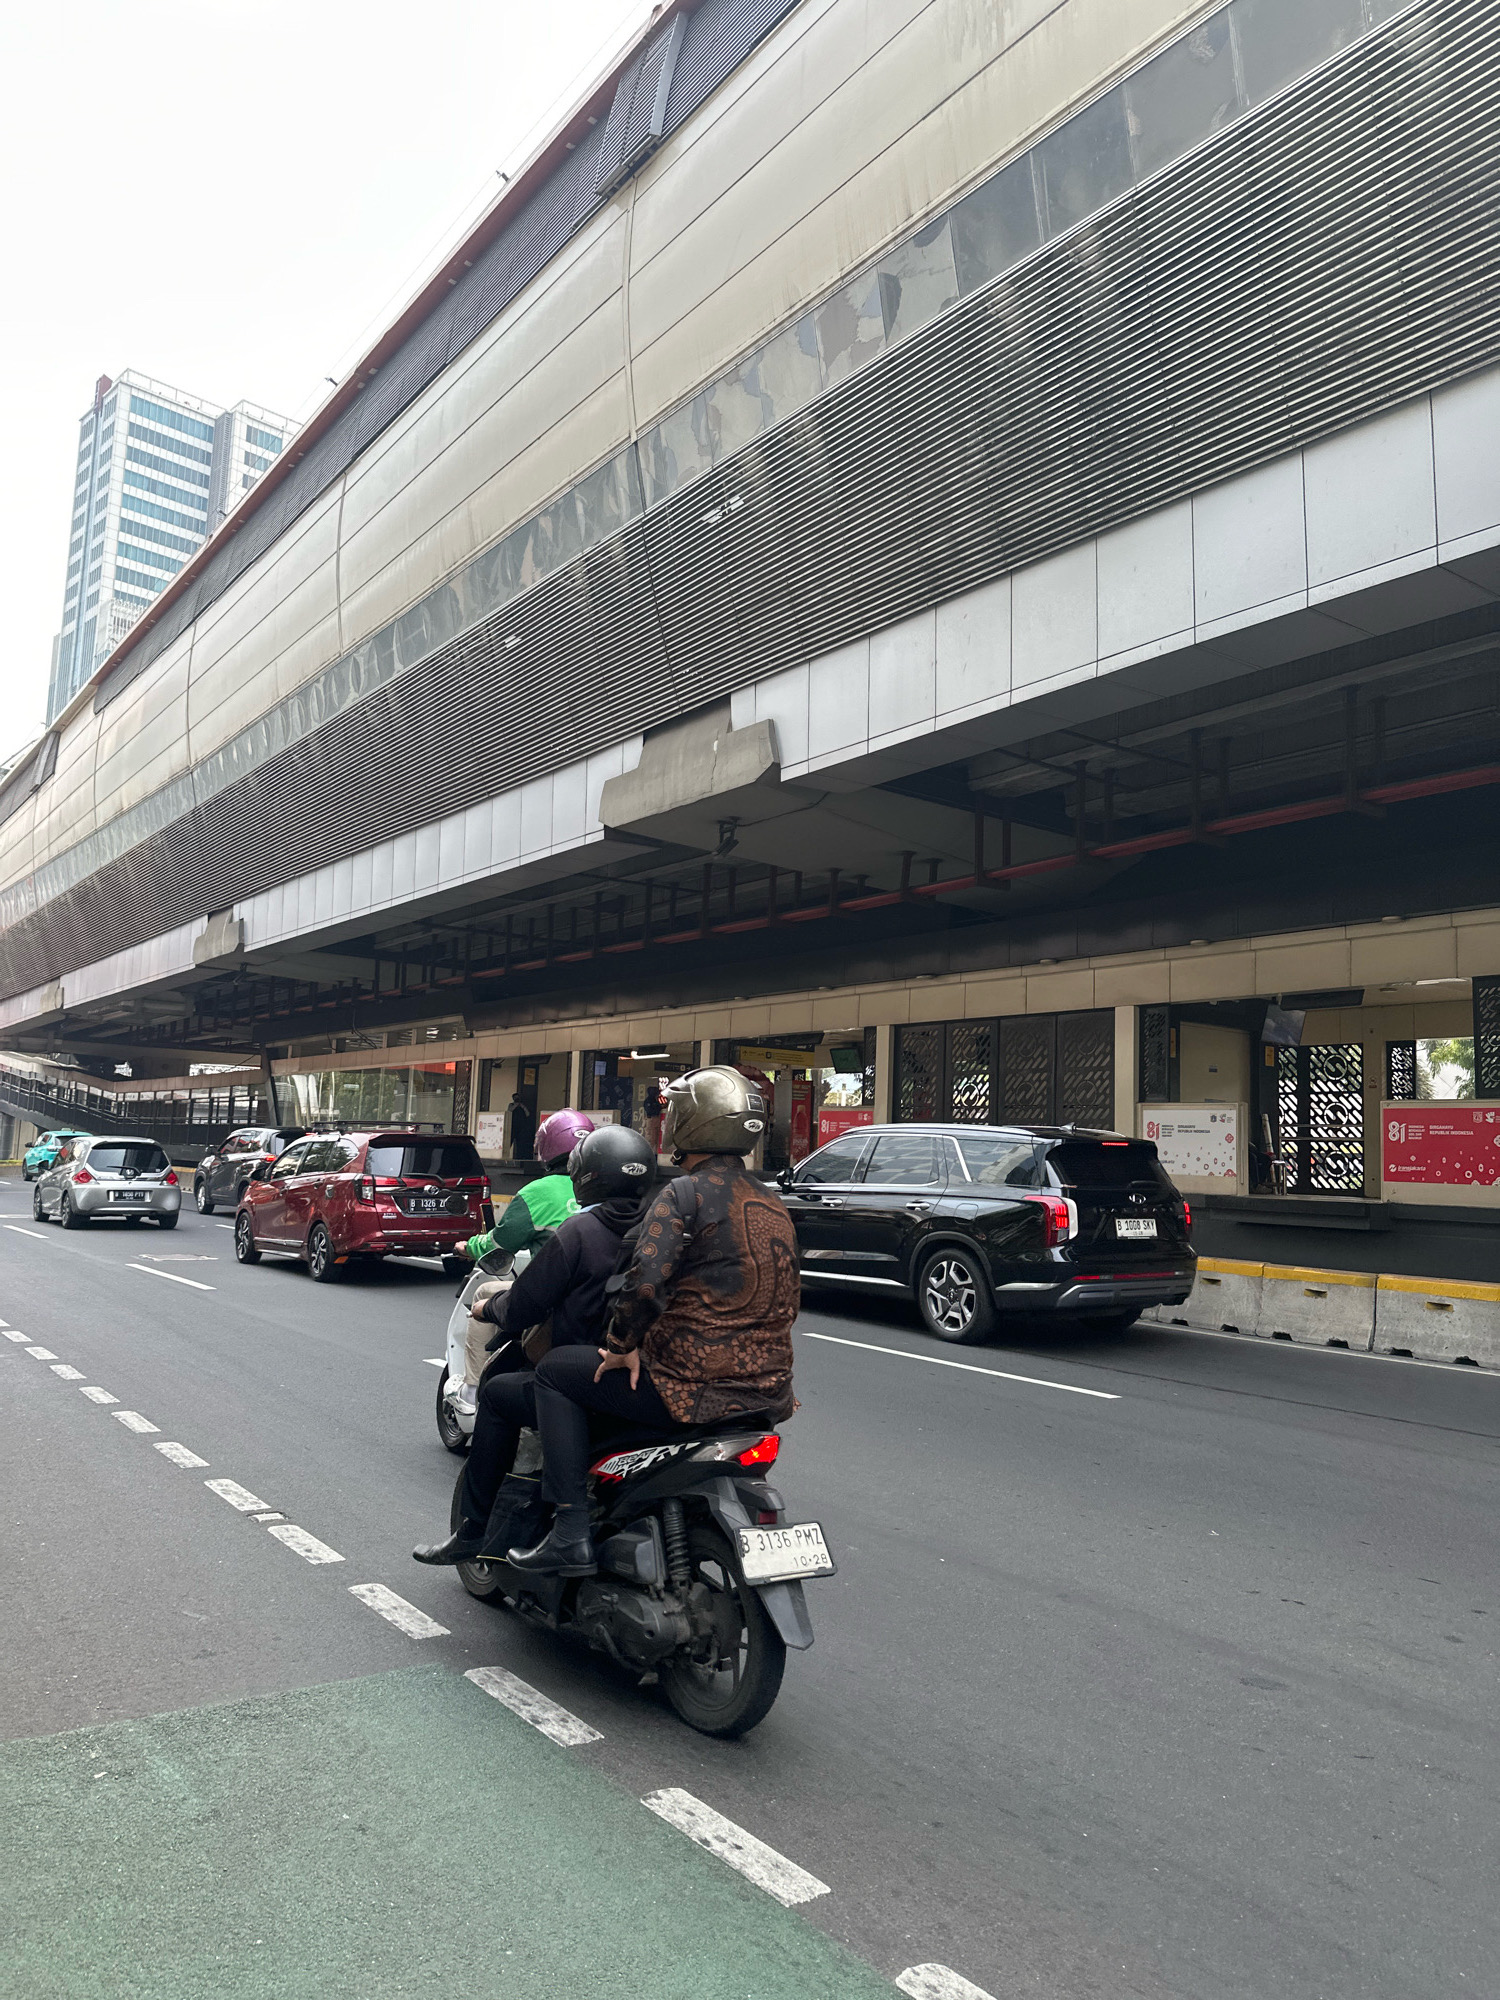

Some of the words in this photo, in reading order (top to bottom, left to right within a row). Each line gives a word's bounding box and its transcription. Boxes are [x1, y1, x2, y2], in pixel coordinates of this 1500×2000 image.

[1147, 1121, 1160, 1140] 81
[1388, 1121, 1407, 1144] 81
[410, 1199, 416, 1207] B
[421, 1199, 436, 1207] 1326
[1117, 1220, 1122, 1230] B
[1143, 1220, 1155, 1230] SKY
[741, 1534, 751, 1554] B
[756, 1531, 792, 1551] 3136
[795, 1528, 823, 1546] PMZ
